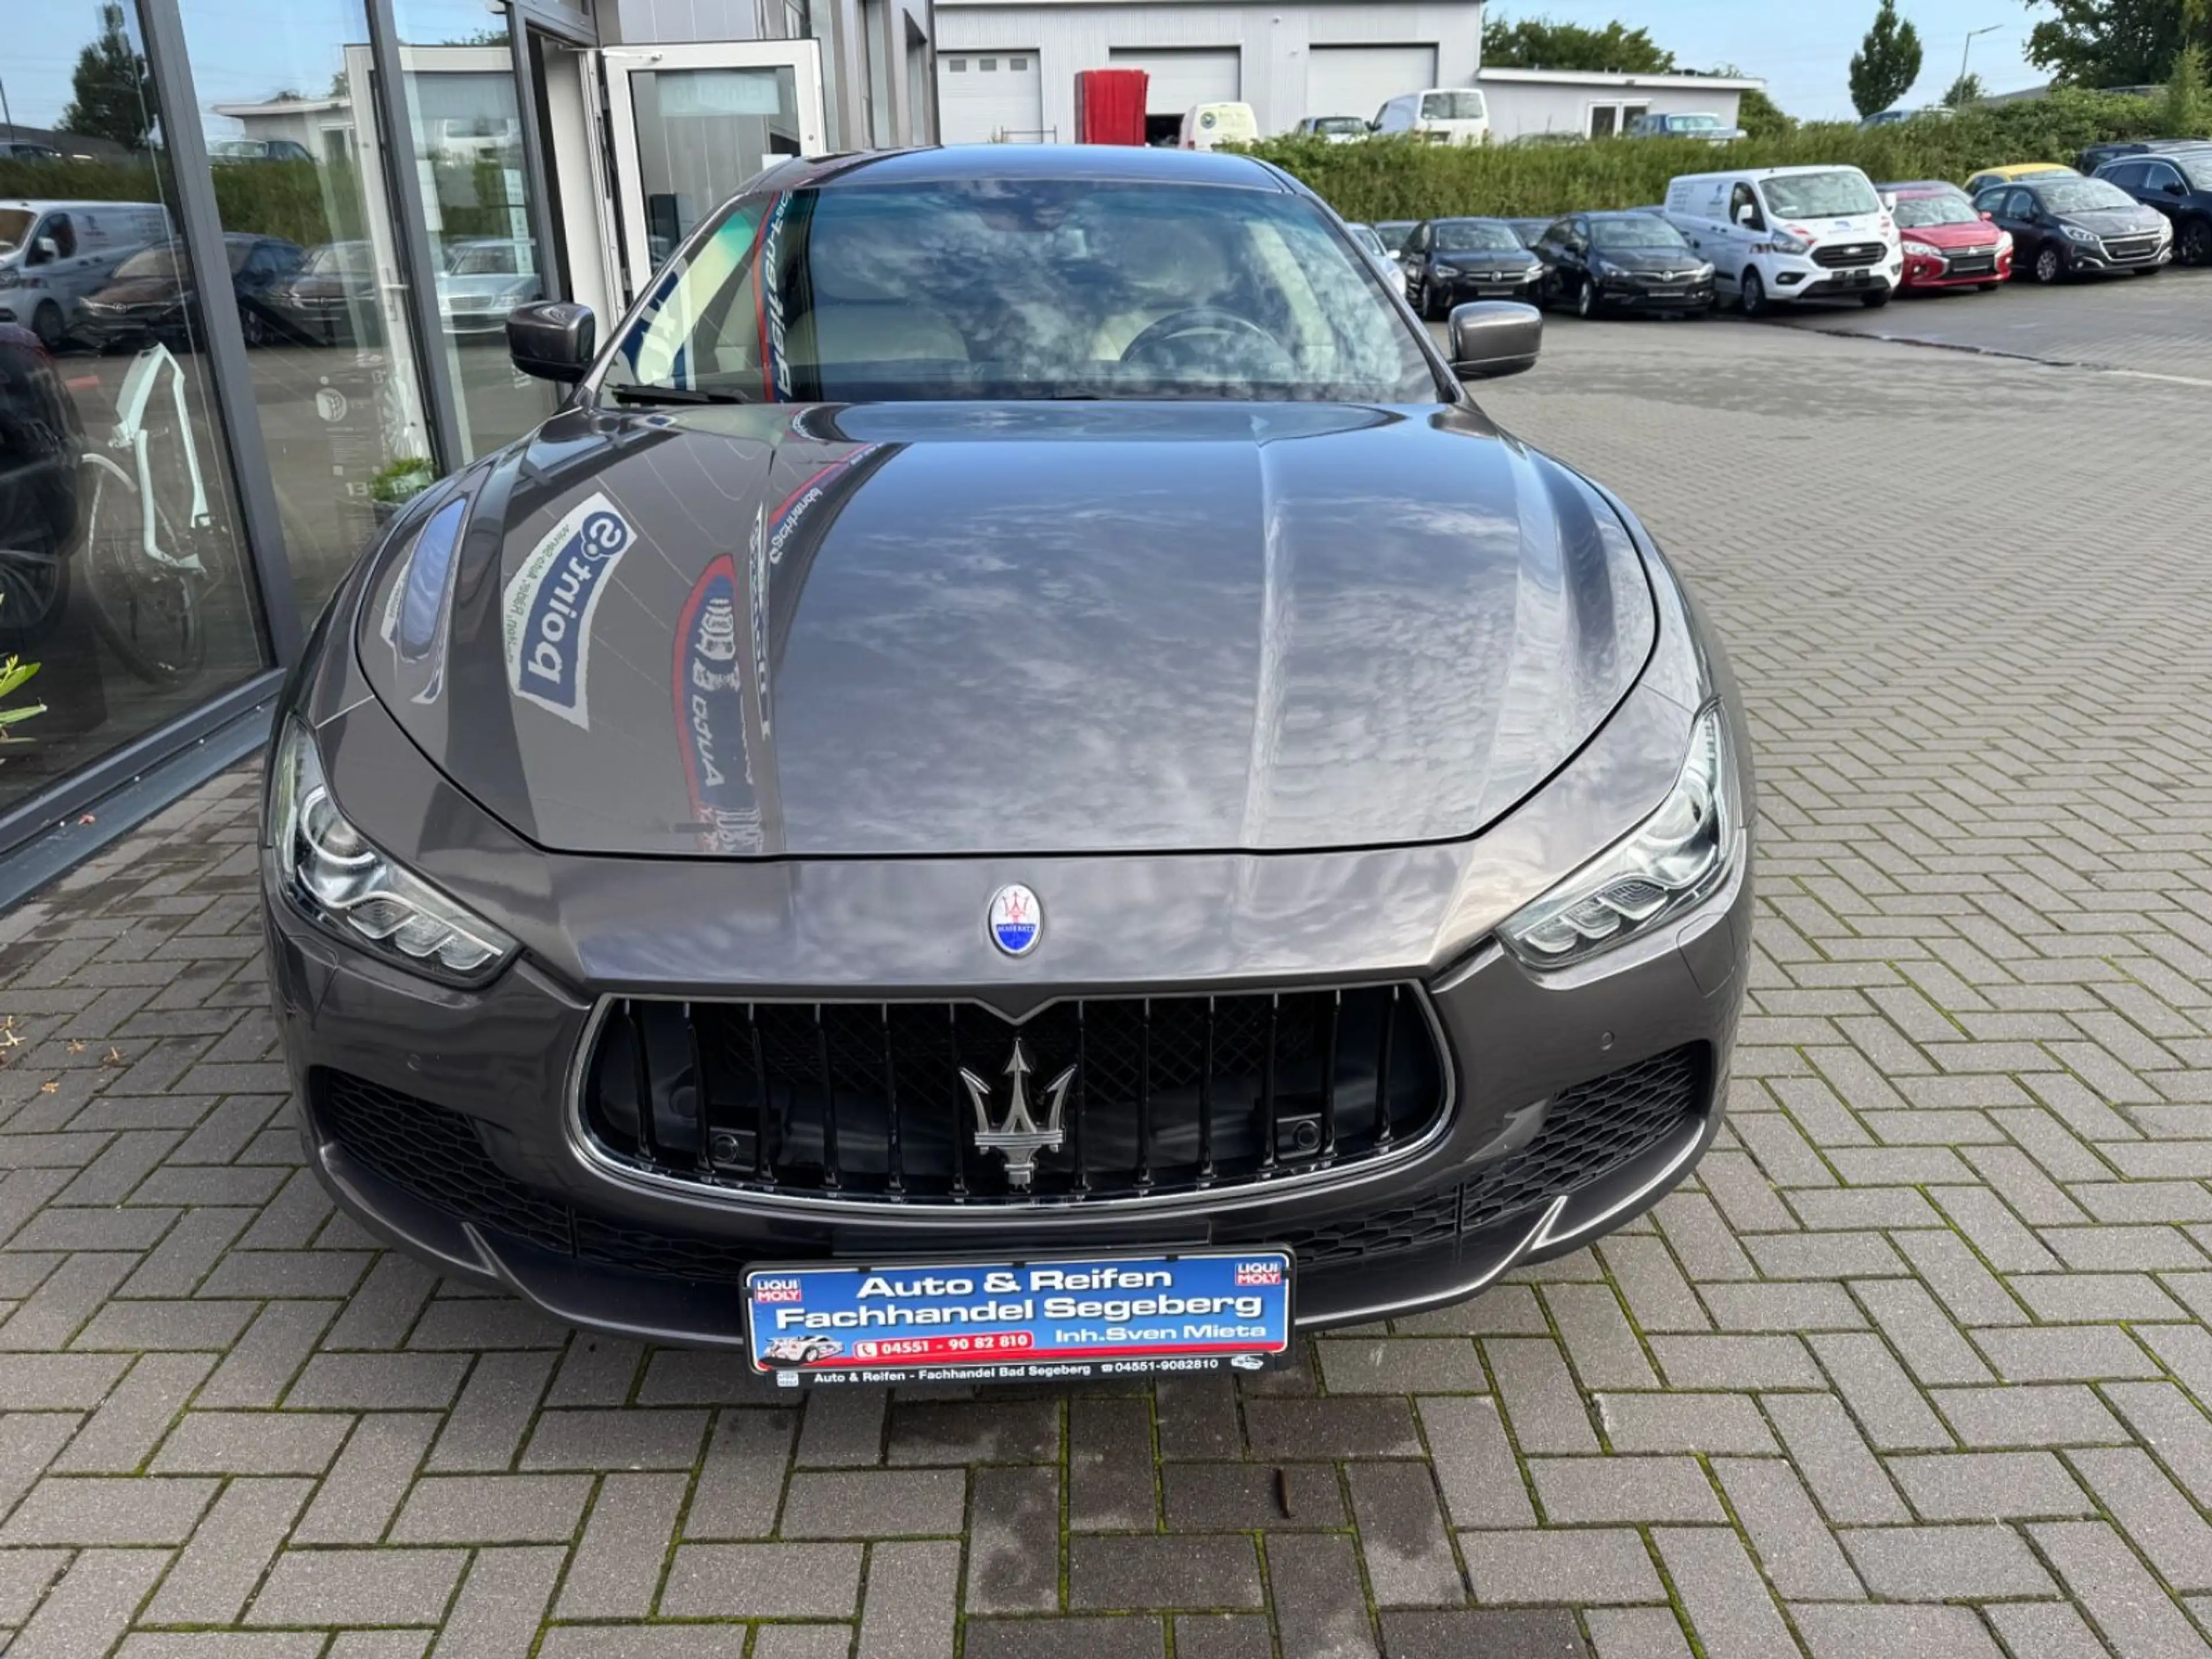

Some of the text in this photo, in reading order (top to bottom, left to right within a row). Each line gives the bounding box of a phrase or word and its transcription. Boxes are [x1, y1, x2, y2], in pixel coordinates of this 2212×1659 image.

[1237, 1263, 1278, 1274] LIQUI
[757, 1278, 798, 1290] LIQUI
[856, 1268, 1172, 1298] Auto & Reifen
[1237, 1272, 1280, 1284] MOLY
[757, 1289, 800, 1302] MOLY
[775, 1294, 1262, 1330] Fachhandel Segeberg
[881, 1340, 929, 1354] 04551
[948, 1338, 969, 1350] 90
[974, 1336, 994, 1349] 82
[999, 1334, 1028, 1347] 810
[814, 1373, 846, 1383] Auto
[849, 1373, 859, 1382] &
[862, 1370, 906, 1382] Reifen
[918, 1368, 995, 1380] Fachhandel
[999, 1366, 1025, 1377] Bad
[1028, 1364, 1092, 1377] Segeberg
[1115, 1359, 1219, 1373] 04551-9082810
